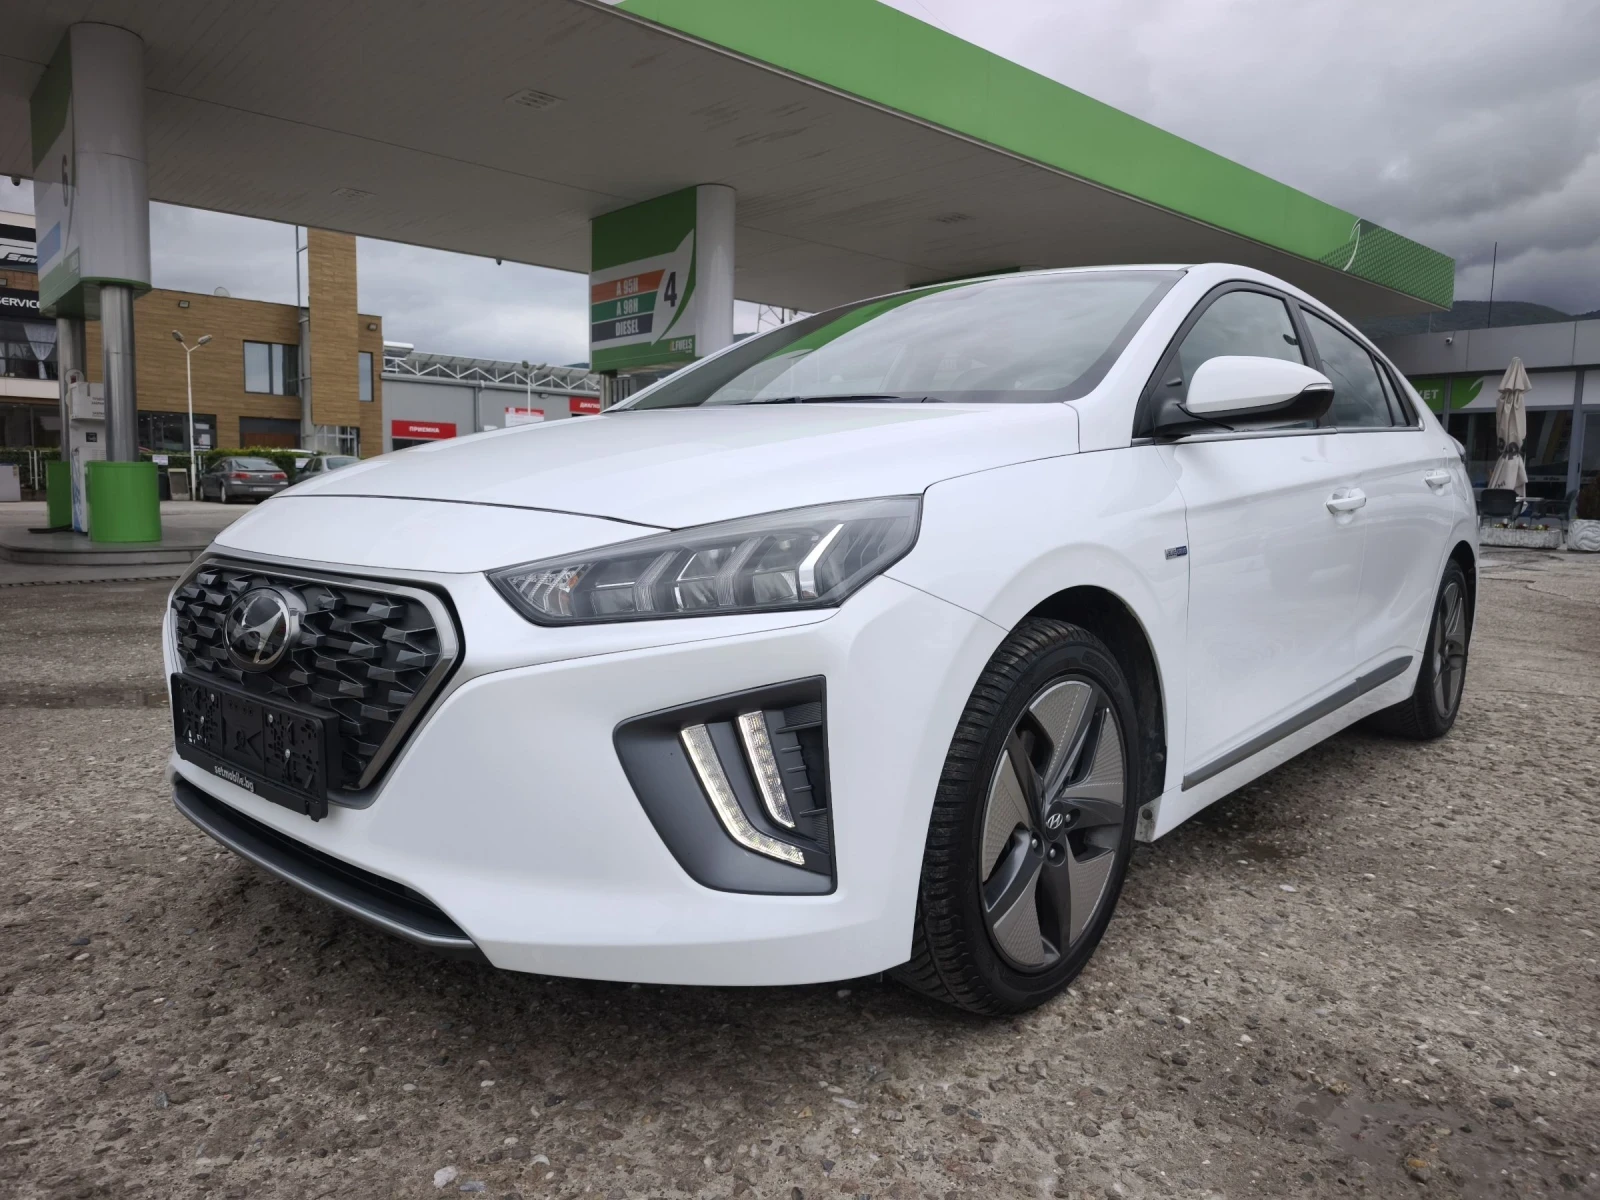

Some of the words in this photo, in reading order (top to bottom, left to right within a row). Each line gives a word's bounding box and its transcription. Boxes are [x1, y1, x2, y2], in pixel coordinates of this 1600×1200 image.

[61, 153, 69, 207] 6
[663, 271, 678, 308] 4
[0, 296, 40, 309] ERVIC
[615, 318, 639, 337] DIESEL
[408, 425, 440, 434] ПРИЕМНА
[214, 765, 255, 793] setmobile.bg
